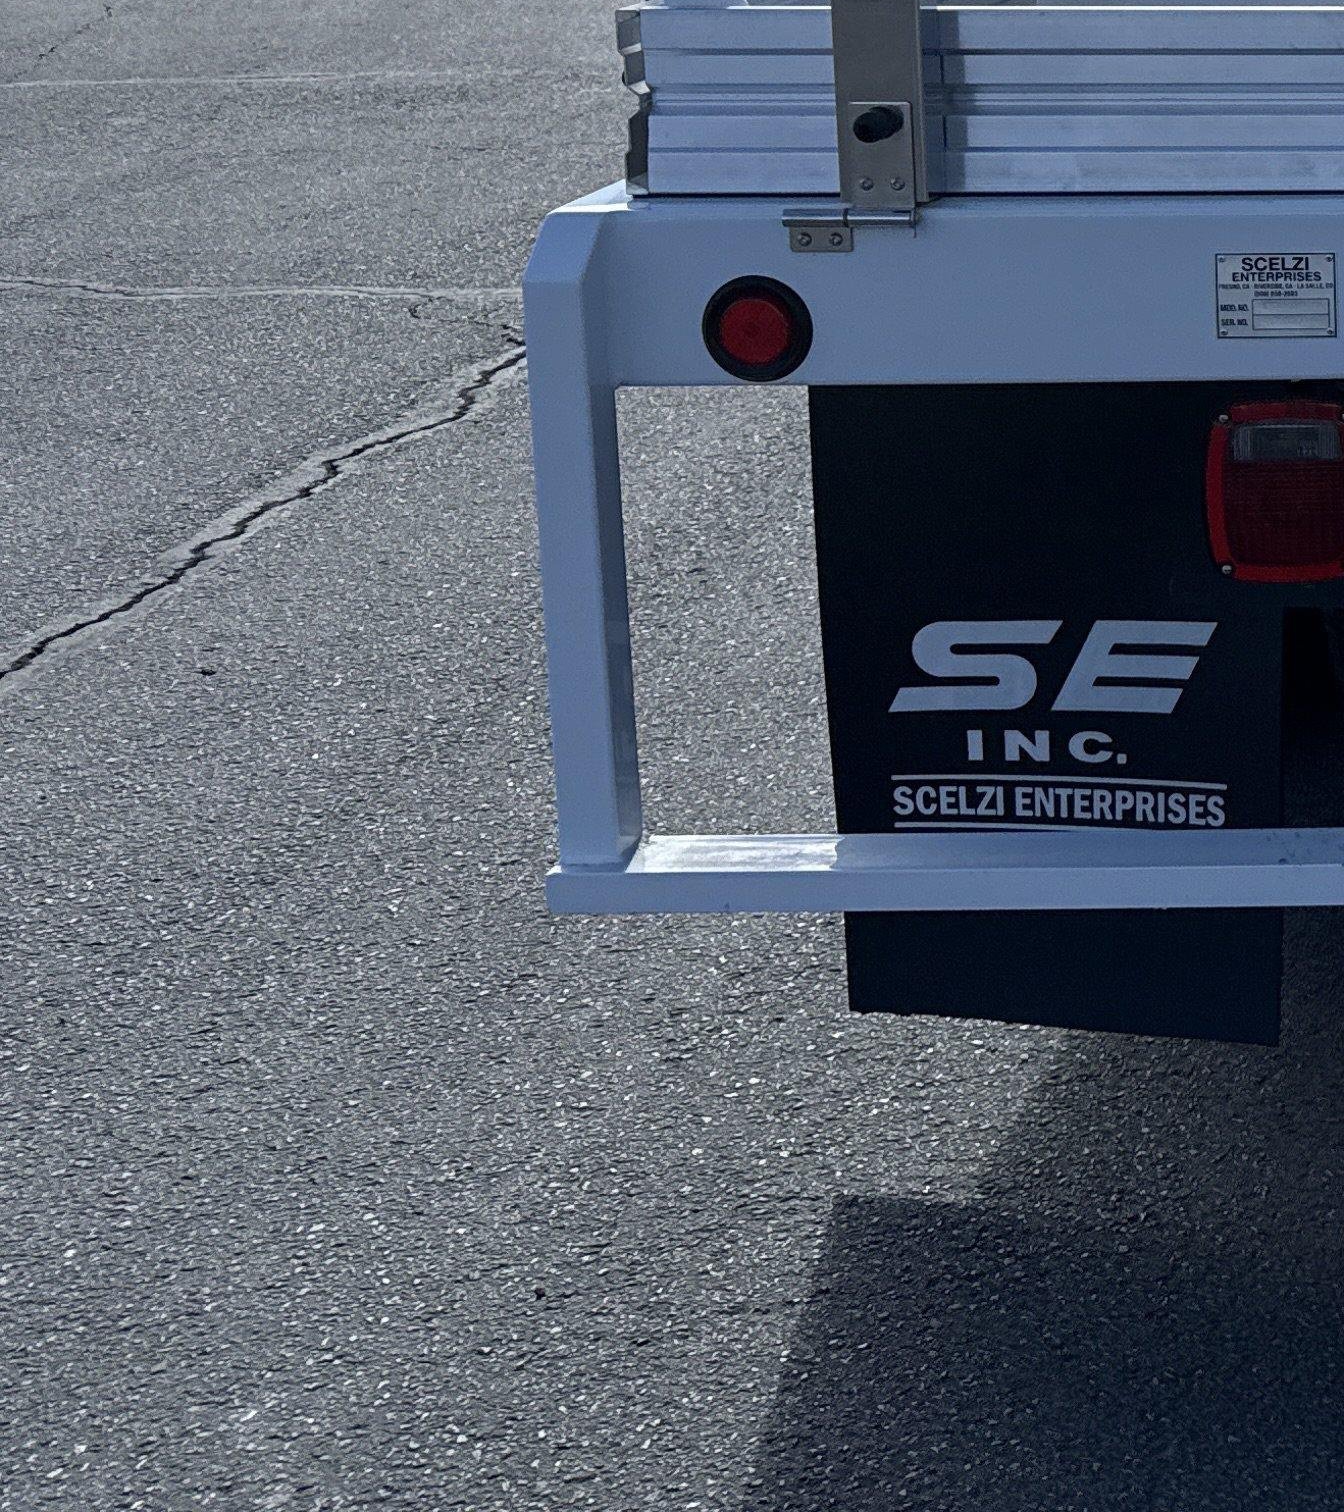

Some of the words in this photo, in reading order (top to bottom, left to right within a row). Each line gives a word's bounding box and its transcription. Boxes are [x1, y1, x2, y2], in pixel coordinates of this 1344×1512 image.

[1232, 272, 1322, 282] ENTERPRISES
[1241, 257, 1309, 271] SCELZI
[888, 619, 1218, 714] SE
[966, 729, 1128, 765] INC.
[892, 785, 1004, 816] SCELZI
[1015, 786, 1226, 827] ENTERPRISES
